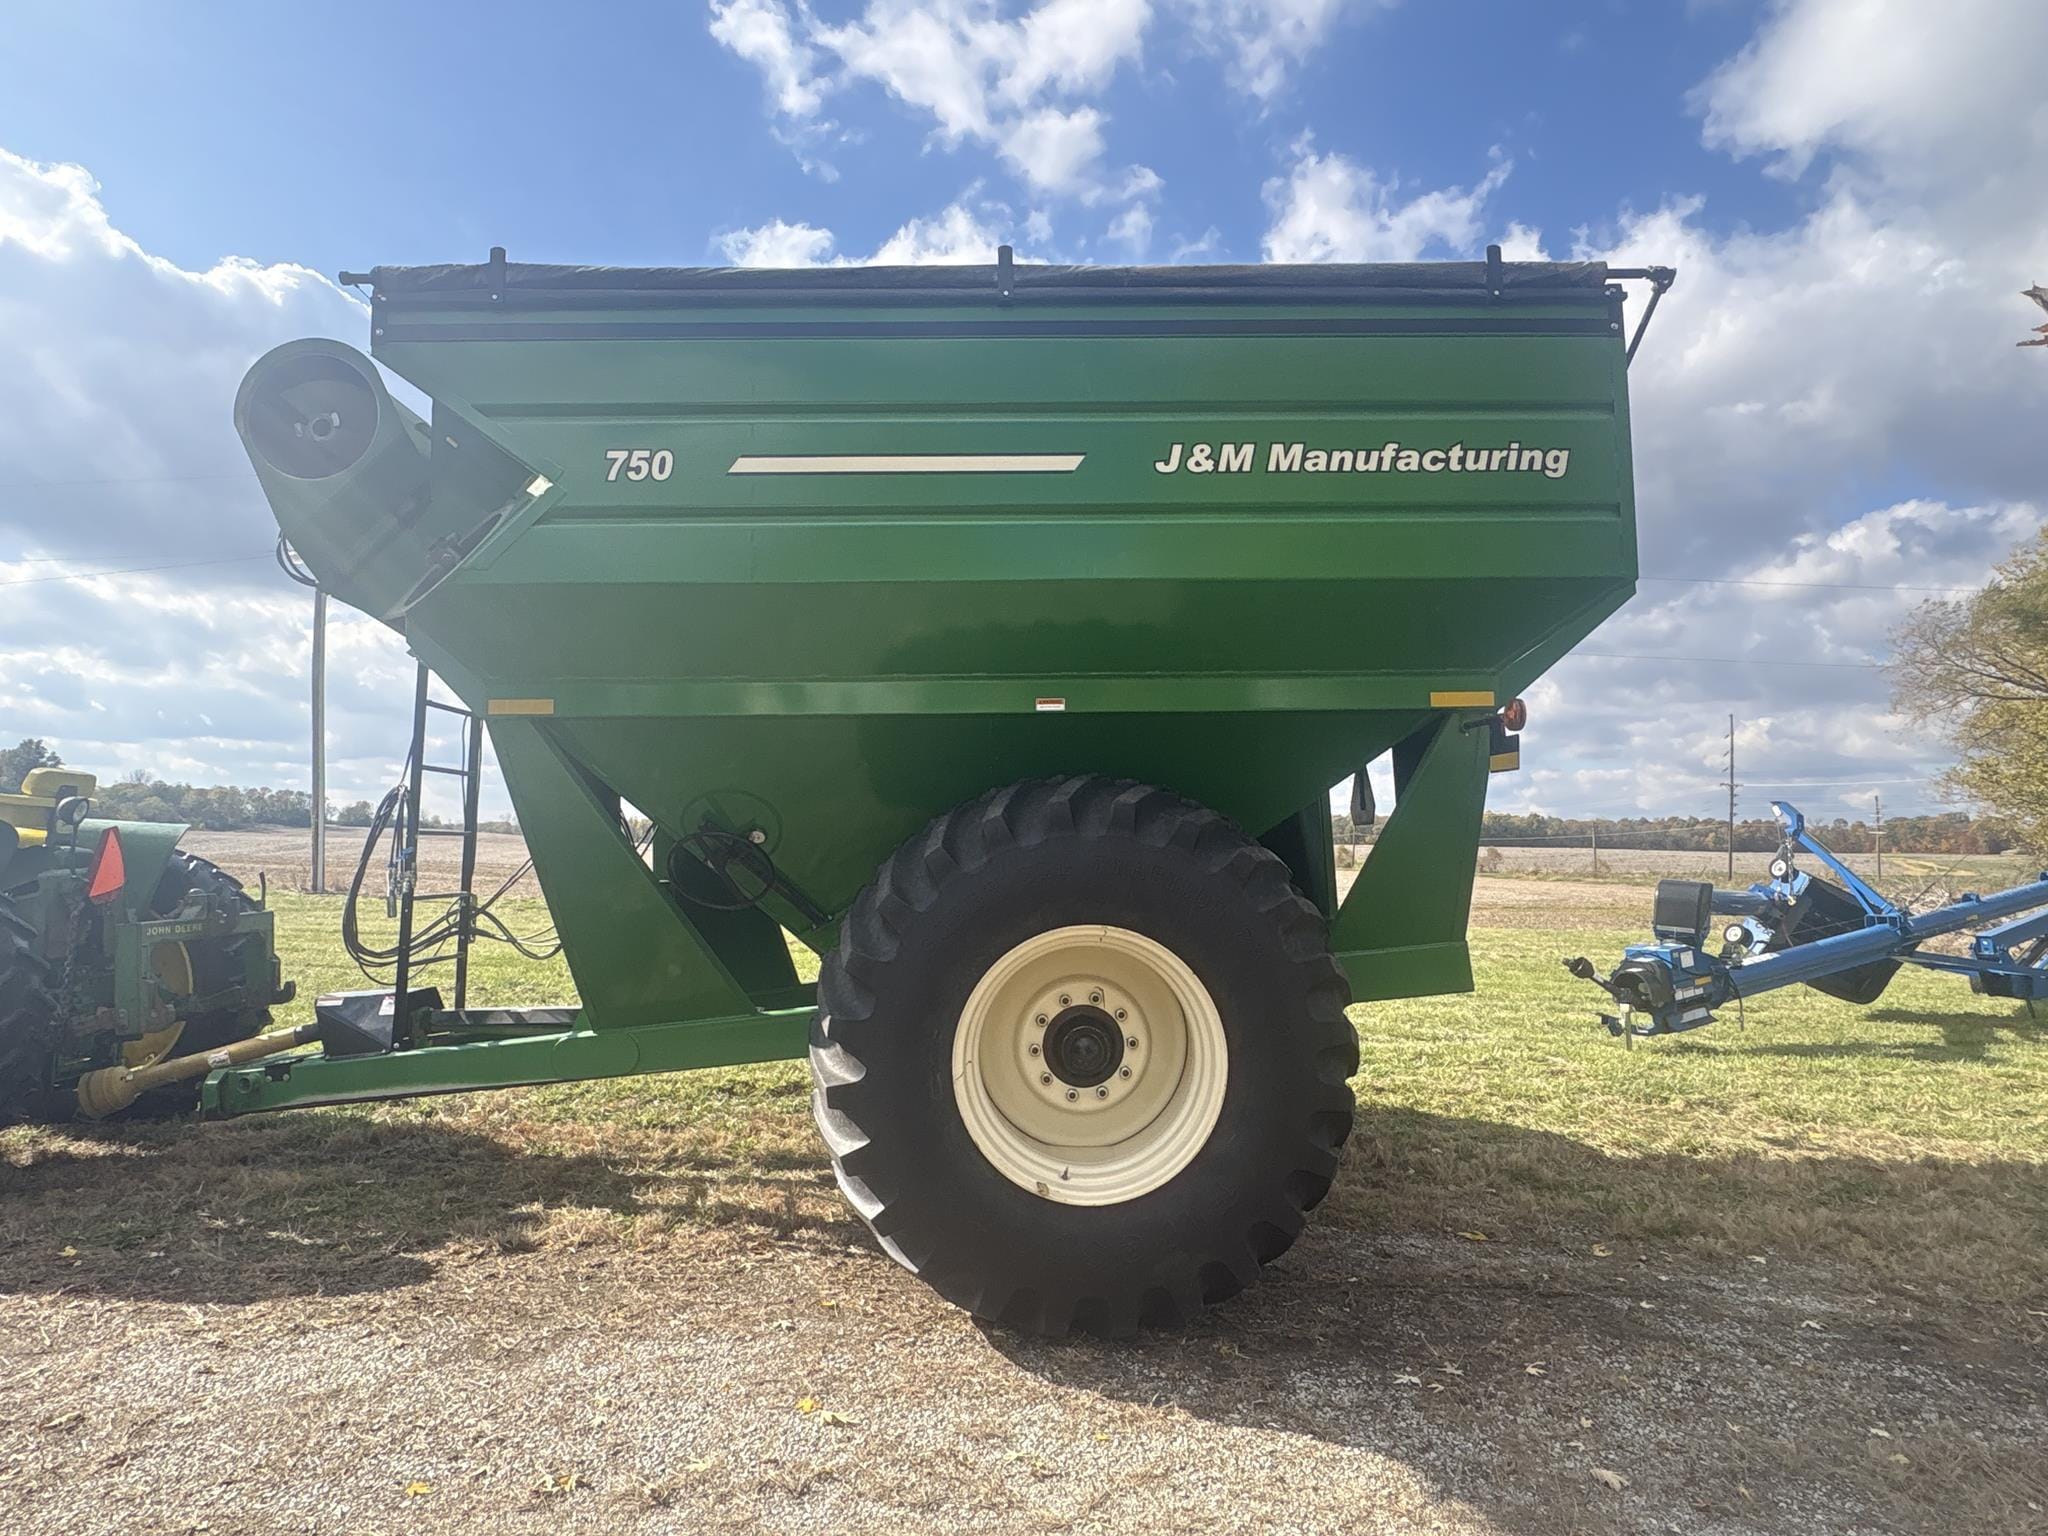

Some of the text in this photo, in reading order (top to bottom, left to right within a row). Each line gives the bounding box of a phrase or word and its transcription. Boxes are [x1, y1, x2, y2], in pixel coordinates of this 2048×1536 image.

[605, 449, 674, 482] 750
[1154, 442, 1571, 479] J&M Manufacturing
[146, 925, 171, 936] JOHN
